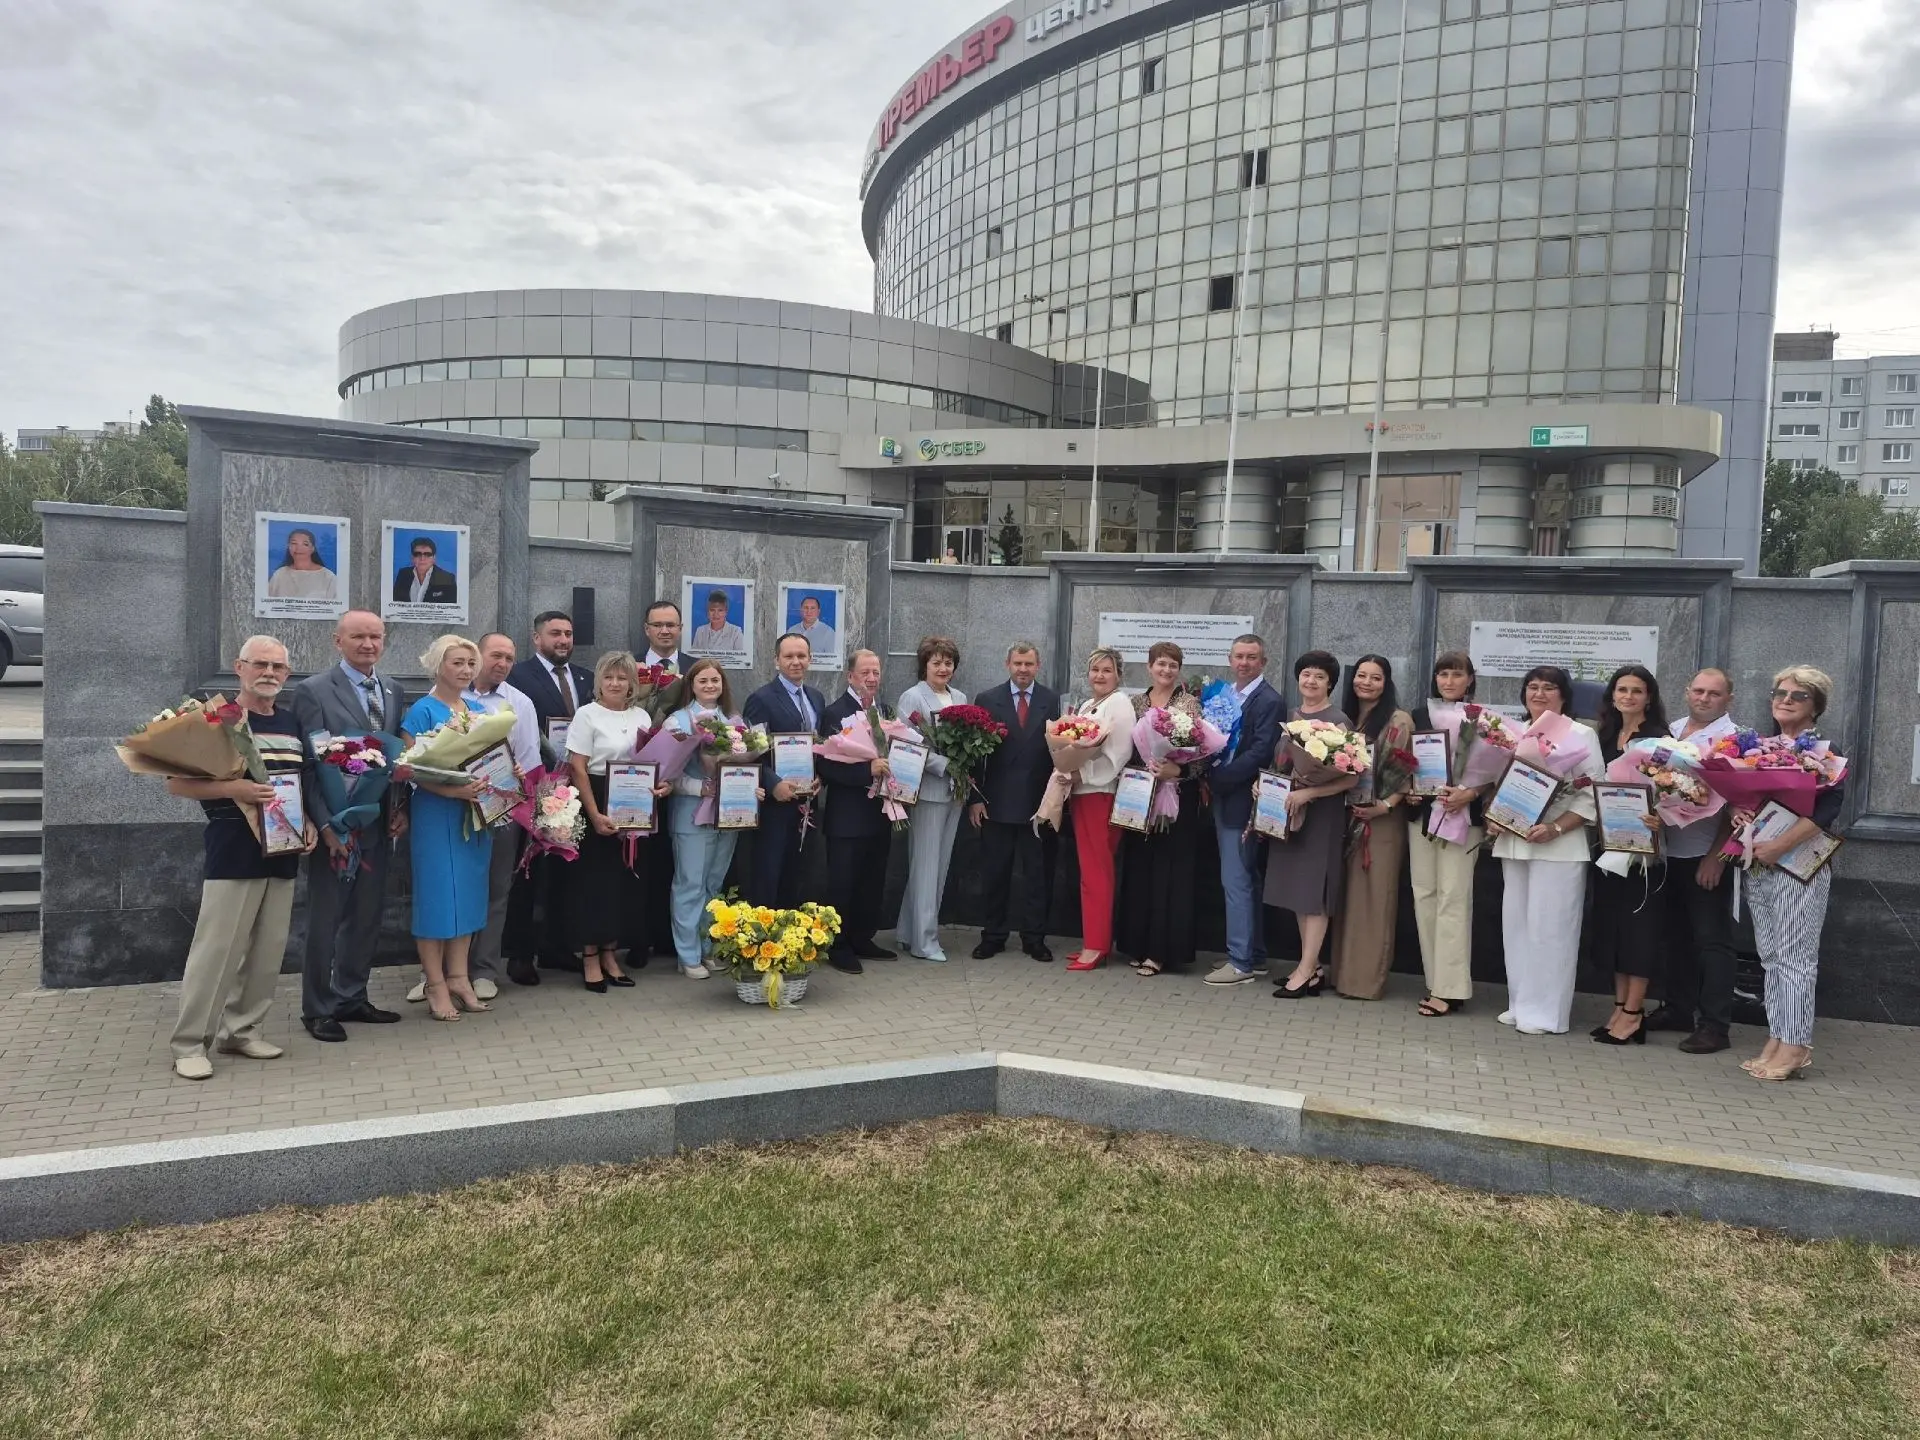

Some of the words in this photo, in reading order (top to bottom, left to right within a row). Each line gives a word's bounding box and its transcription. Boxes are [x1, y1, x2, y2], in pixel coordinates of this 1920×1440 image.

[879, 15, 1014, 151] ПРЕМЬЕР
[1026, 0, 1112, 42] ЦЕН
[941, 441, 985, 456] СБЕР
